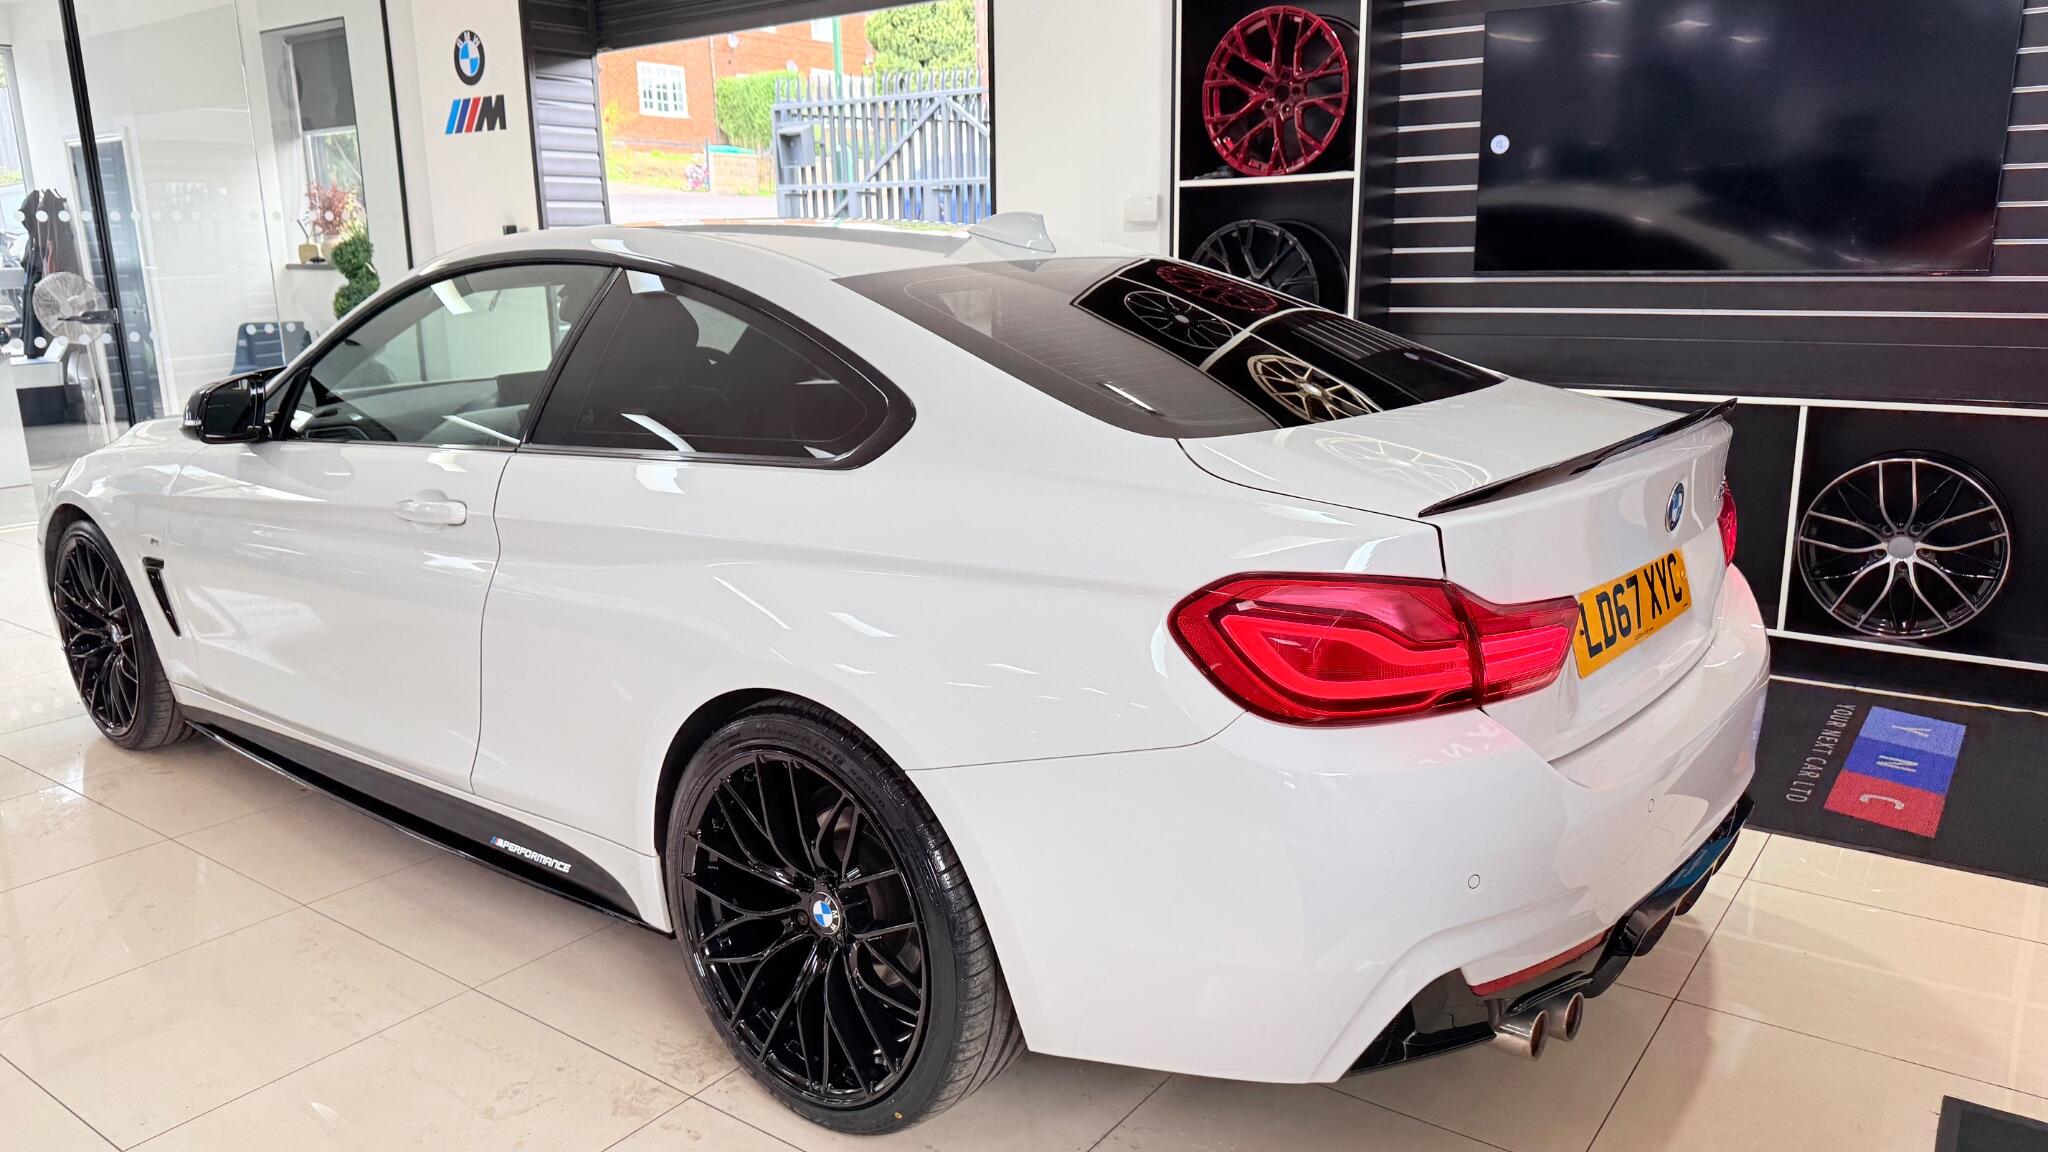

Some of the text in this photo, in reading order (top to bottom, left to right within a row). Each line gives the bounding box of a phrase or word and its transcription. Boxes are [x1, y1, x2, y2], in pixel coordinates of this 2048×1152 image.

[1579, 553, 1683, 659] LD67 XYC
[1785, 704, 1856, 803] YOUR NEXT CAR LTD
